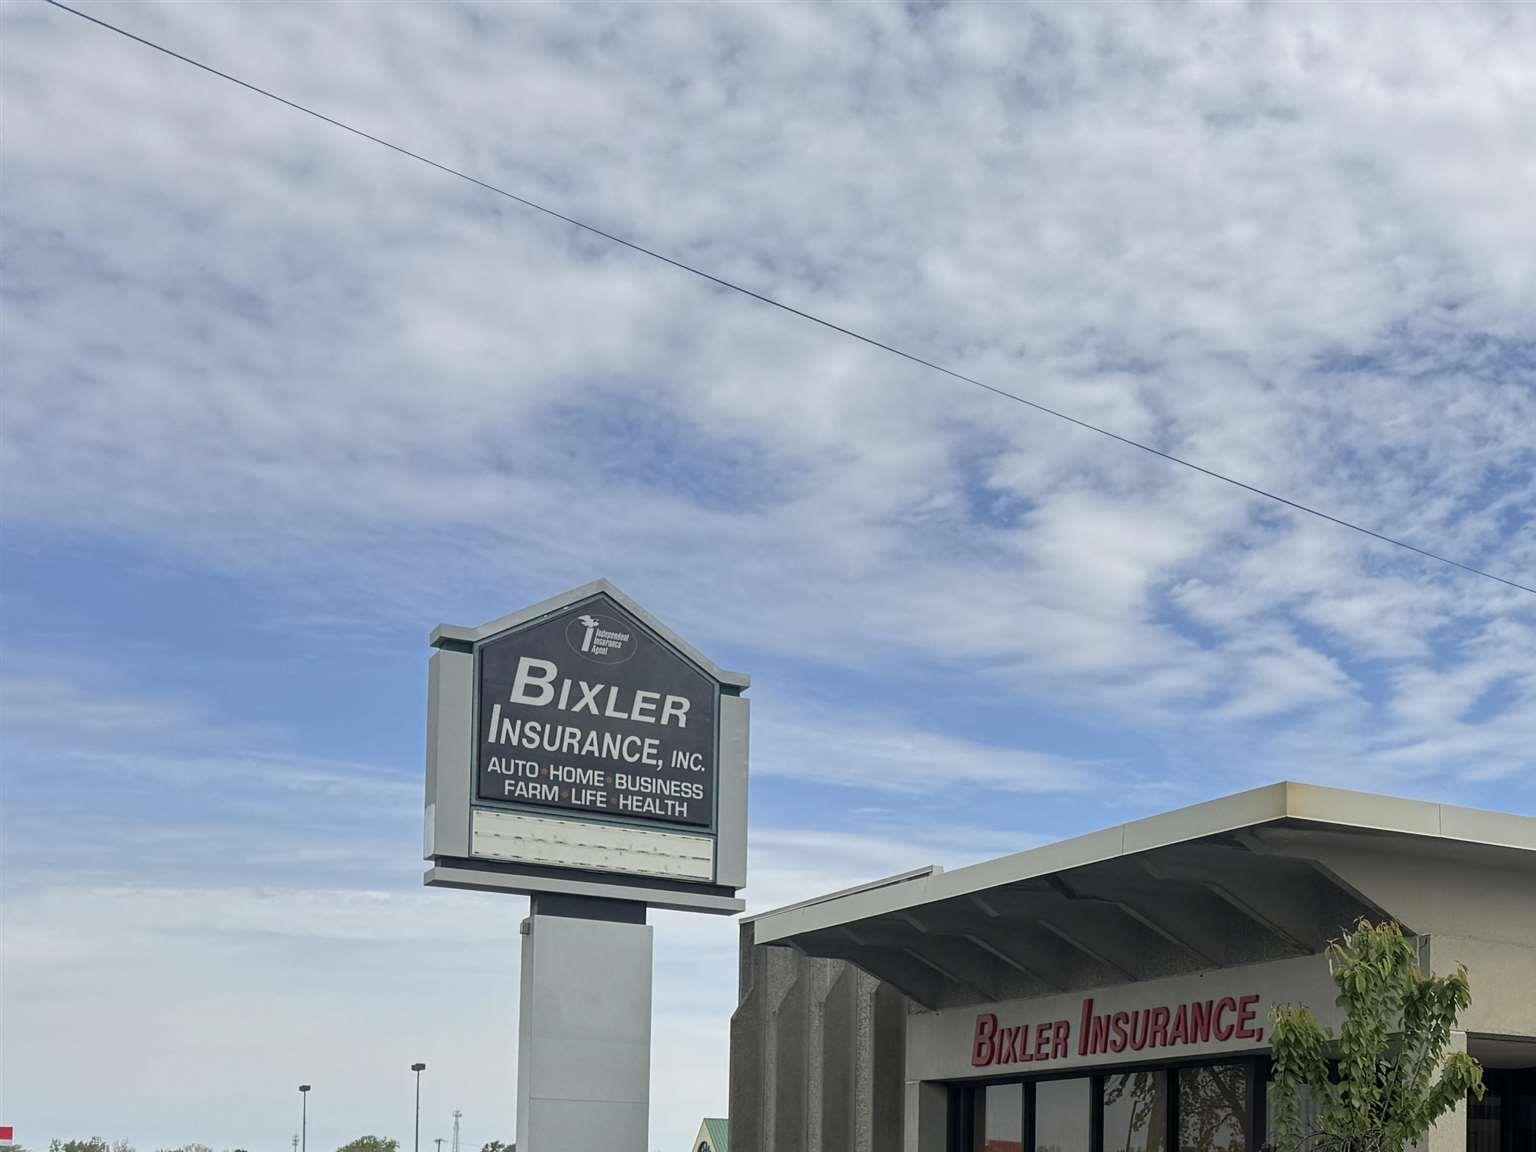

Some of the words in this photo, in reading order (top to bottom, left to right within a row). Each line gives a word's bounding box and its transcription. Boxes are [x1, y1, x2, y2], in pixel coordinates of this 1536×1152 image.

[591, 645, 608, 656] Agent
[593, 638, 622, 649] Insurance
[510, 656, 691, 728] BIXLER
[487, 703, 663, 771] INSURANCE,
[670, 749, 706, 772] INC.
[487, 756, 539, 778] AUTO
[549, 764, 605, 787] HOME
[615, 772, 704, 800] BUSINESS
[504, 779, 559, 802] FARM
[571, 787, 607, 807] LIFE
[619, 794, 688, 818] HEALTH
[971, 1012, 1071, 1068] BIXLER
[1078, 994, 1264, 1056] INSURANCE,
